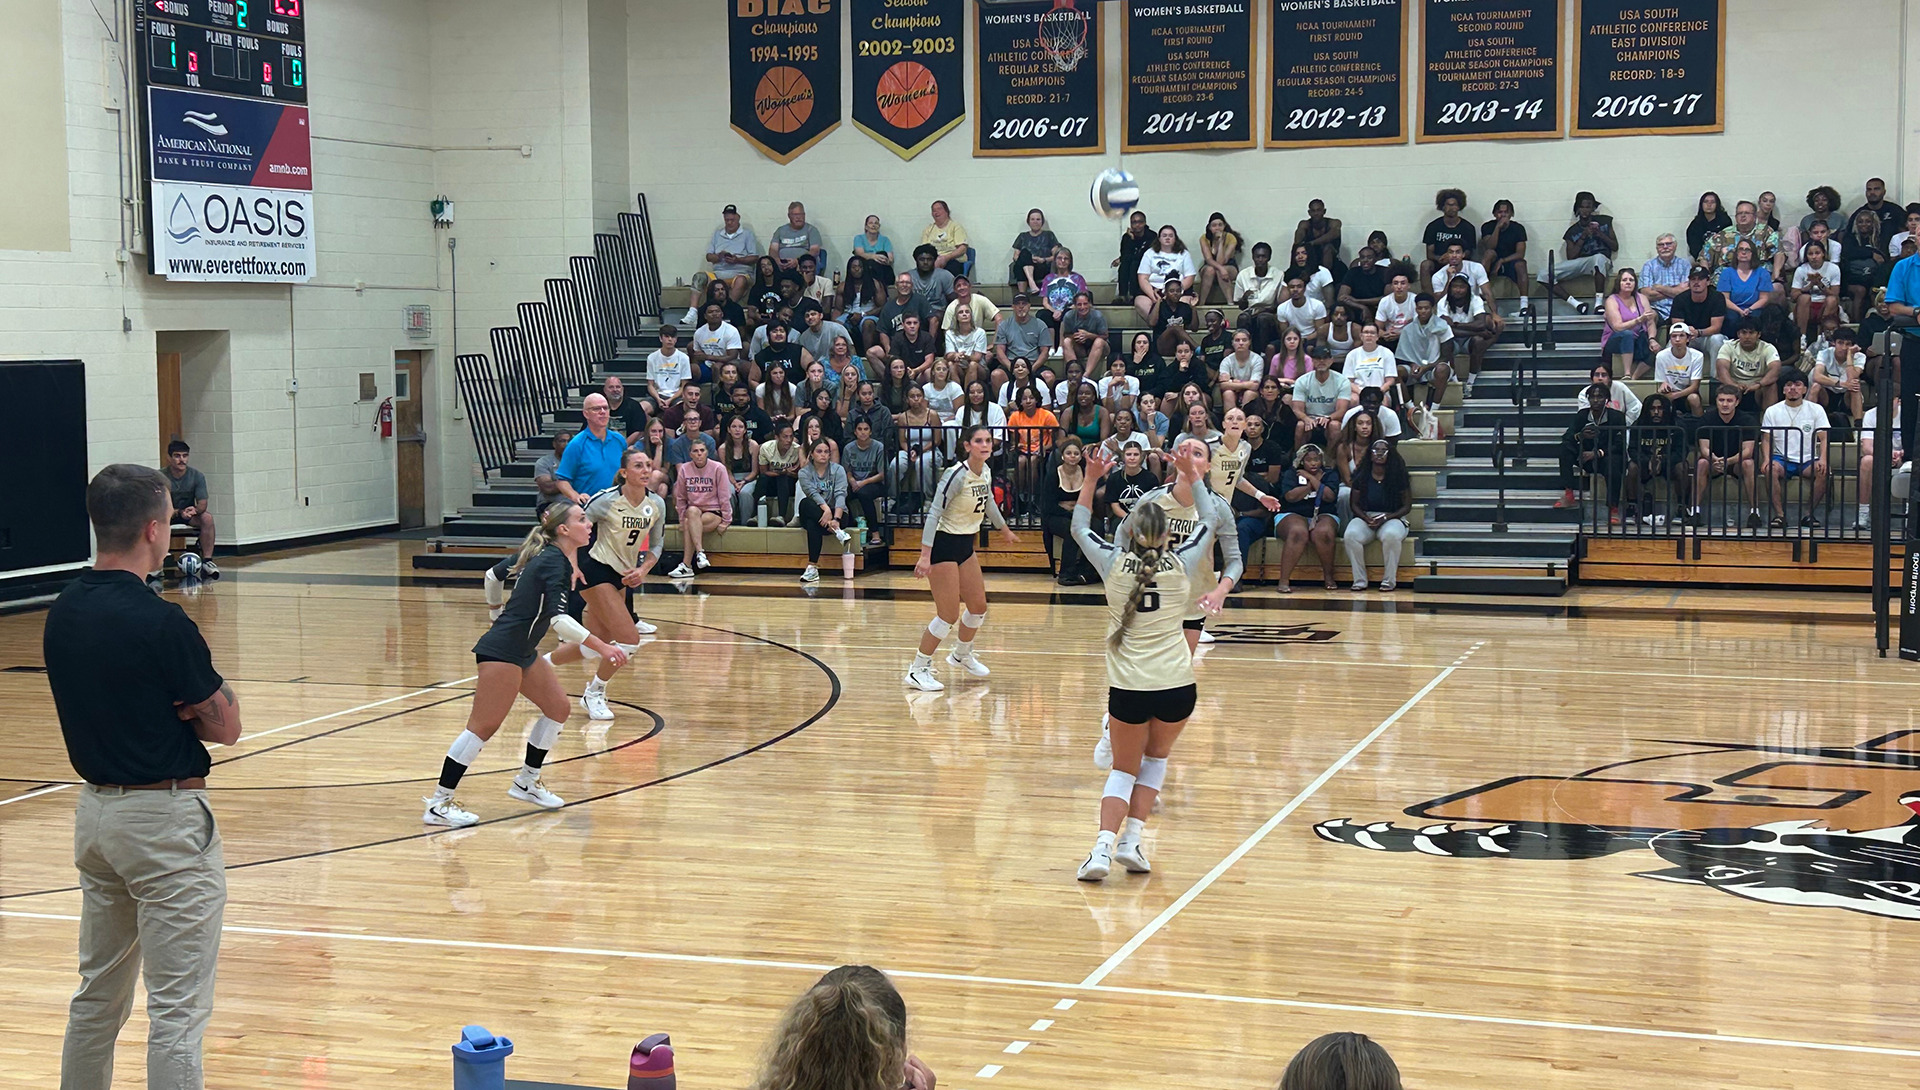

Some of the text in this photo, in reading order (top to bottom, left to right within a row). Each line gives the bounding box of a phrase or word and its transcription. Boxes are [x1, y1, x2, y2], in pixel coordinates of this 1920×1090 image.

[163, 1, 189, 16] BONUS
[208, 0, 234, 16] PERIOD
[1134, 4, 1244, 17] WOMEN'S BASKETBALL
[1280, 0, 1330, 11] WOMEN'S
[236, 0, 248, 28] 2
[985, 11, 1092, 24] WOMEN'S BASKETBALL
[1450, 10, 1532, 22] NCAA TOURNAMENT
[1620, 8, 1679, 20] USA SOUTH
[266, 20, 289, 34] BONUS
[871, 13, 941, 32] Champions
[1296, 19, 1376, 30] NCAA TOURNAMENT
[1458, 22, 1524, 32] SECOND ROUND
[1590, 20, 1709, 36] ATHLETIC CONFERENCE
[151, 22, 176, 37] FOULS
[1152, 24, 1226, 36] NCAA TOURNAMENT
[206, 31, 259, 50] PLAYER FOULS
[1012, 39, 1031, 48] USA
[1164, 36, 1214, 46] FIRST ROUND
[1310, 32, 1363, 42] FIRST ROUND
[1468, 37, 1514, 47] USA SOUTH
[1612, 36, 1686, 48] EAST DIVISION
[282, 43, 302, 58] FOULS
[858, 36, 955, 56] 2002-2003
[170, 41, 177, 68] 1
[750, 45, 818, 63] 1994-1995
[988, 51, 1028, 62] ATHLETIC
[1168, 50, 1210, 60] USA SOUTH
[1314, 51, 1358, 60] USA SOUTH
[1444, 47, 1537, 59] ATHLETIC CONFERENCE
[1616, 49, 1680, 62] CHAMPIONS
[998, 63, 1077, 75] REGULAR SEA
[1146, 60, 1230, 72] ATHLETIC CONFERENCE
[1290, 62, 1381, 74] ATHLETIC CONFERENCE
[1429, 58, 1553, 70] REGULAR SEASON CHAMPIONS
[292, 59, 302, 86] 0
[1132, 70, 1246, 84] REGULAR SEASON CHAMPIONS
[1438, 69, 1544, 82] TOURNAMENT CHAMPIONS
[1610, 68, 1686, 81] RECORD: 18-9
[186, 74, 200, 87] TOL
[1011, 76, 1066, 88] CHAMPIONS
[1277, 74, 1396, 86] REGULAR SEASON CHAMPIONS
[1462, 80, 1519, 92] RECORD: 27-3
[261, 84, 274, 97] TOL
[878, 80, 936, 108] Women's
[1140, 82, 1238, 94] TOURNAMENT CHAMPIONS
[1308, 87, 1364, 98] RECORD: 24-5
[757, 89, 814, 116] Women's
[1006, 93, 1070, 104] RECORD: 21-7
[1163, 93, 1214, 104] RECORD: 23-6
[1437, 98, 1544, 124] 2013-14
[1592, 93, 1703, 118] 2016-17
[1142, 110, 1234, 134] 2011-12
[1284, 105, 1386, 130] 2012-13
[988, 116, 1089, 140] 2006-07
[158, 134, 252, 156] AMERICAN NATIONAL
[158, 156, 252, 171] BANK & TRUST COMPANY
[269, 164, 308, 176] amnb.com
[204, 194, 305, 238] OASIS
[282, 242, 305, 250] SERVICES
[169, 256, 306, 276] www.everettfoxx.com
[1225, 471, 1236, 486] 5
[622, 516, 651, 530] FERRUM
[1167, 518, 1198, 534] ERRU
[626, 530, 640, 546] 9
[1908, 552, 1920, 615] sports imports
